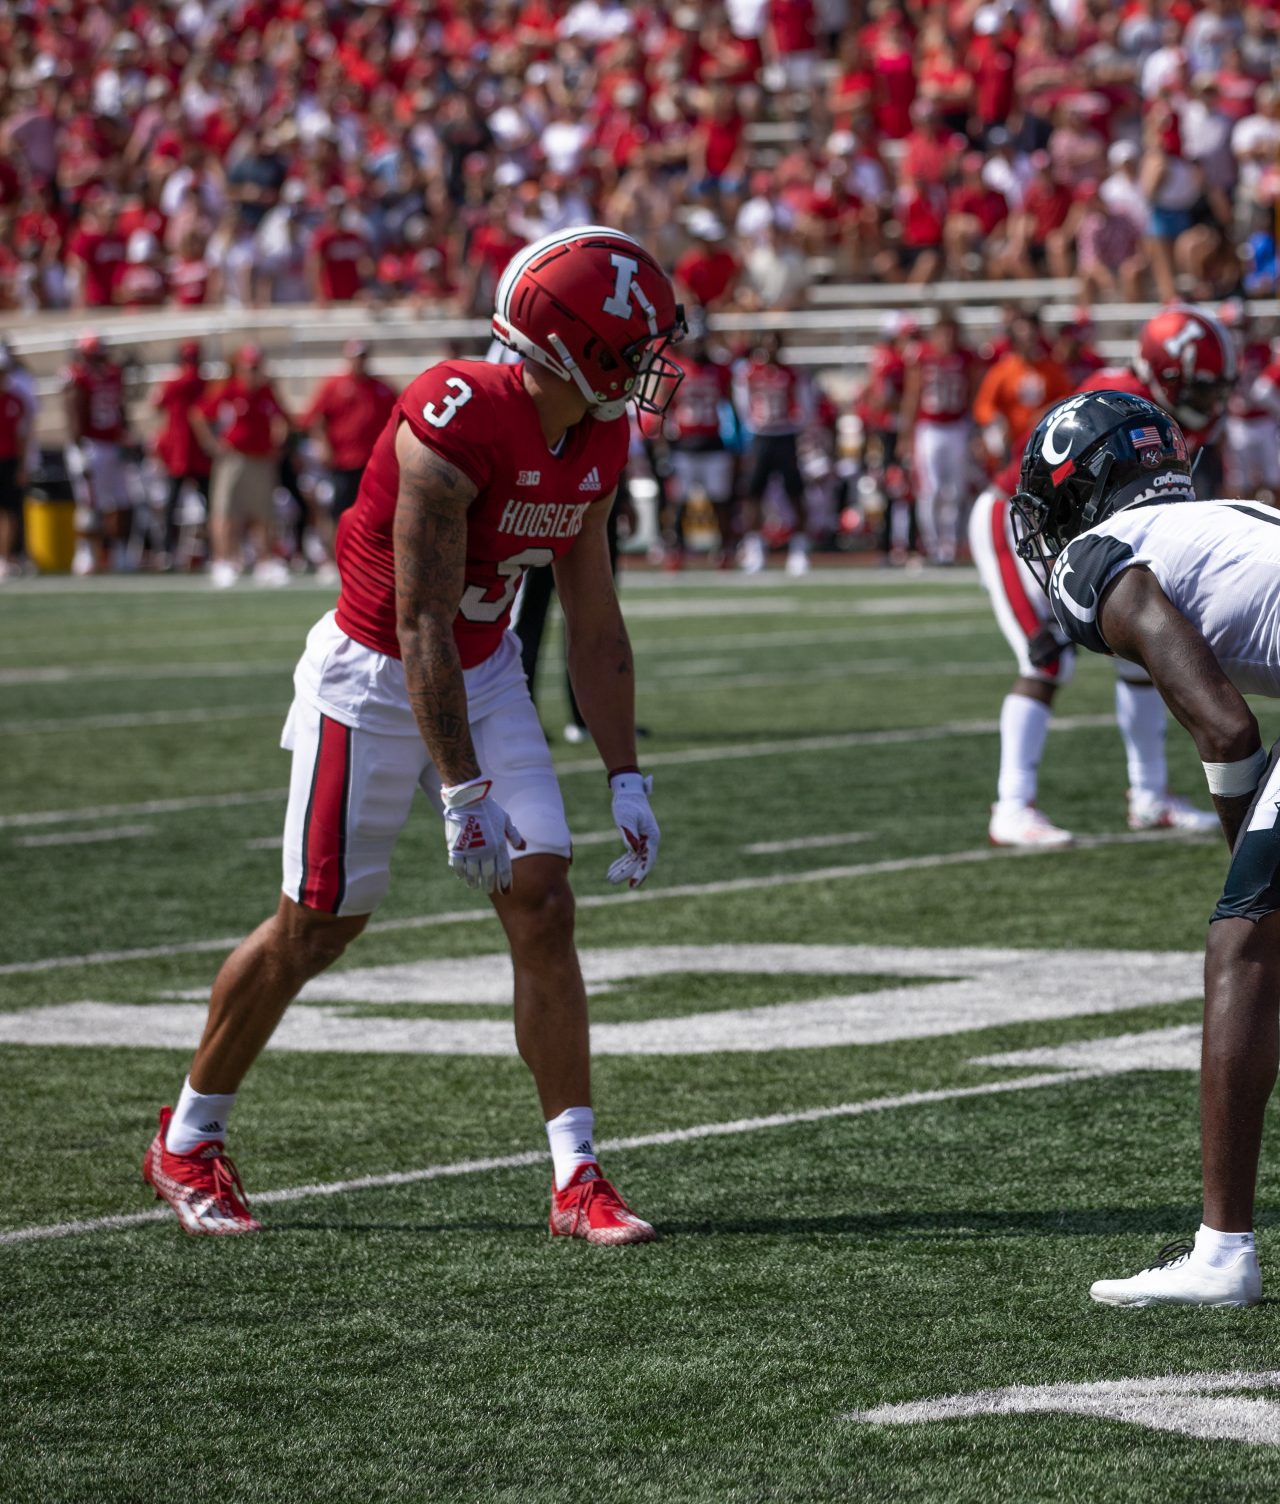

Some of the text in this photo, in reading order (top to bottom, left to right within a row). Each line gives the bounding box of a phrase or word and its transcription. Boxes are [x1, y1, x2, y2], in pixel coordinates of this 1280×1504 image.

[603, 253, 638, 320] I
[422, 377, 473, 429] 3
[460, 548, 554, 622] 3
